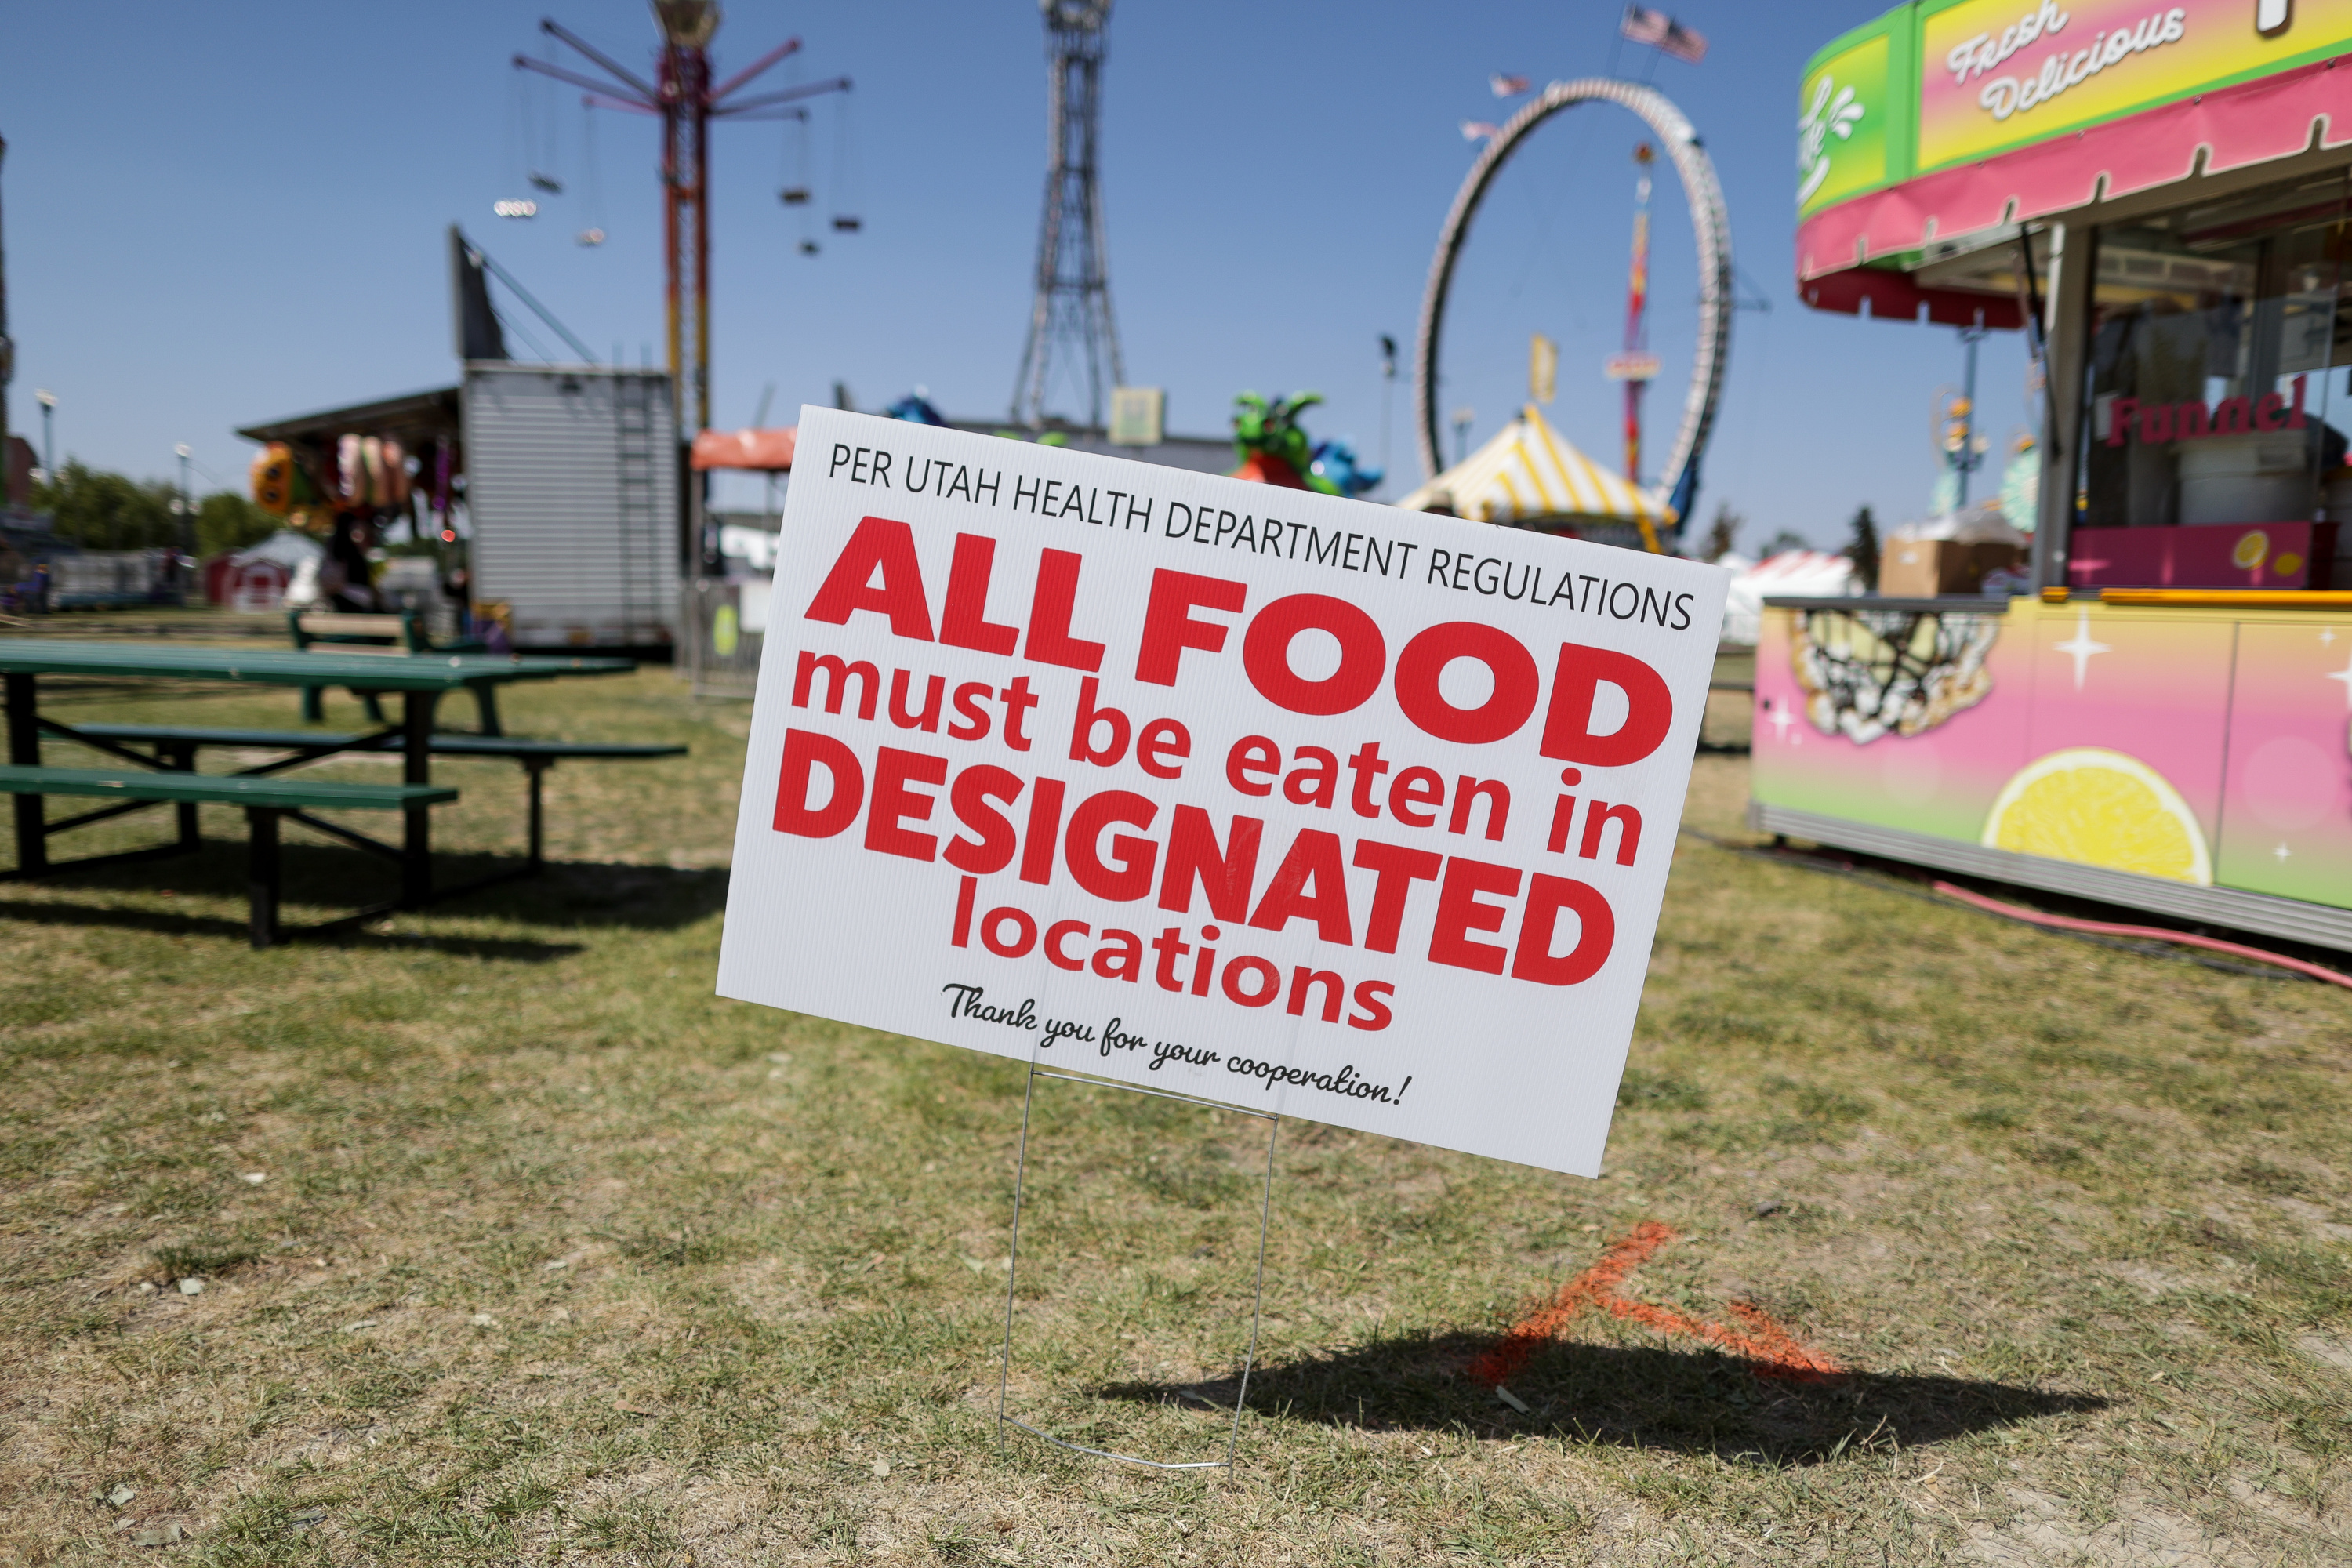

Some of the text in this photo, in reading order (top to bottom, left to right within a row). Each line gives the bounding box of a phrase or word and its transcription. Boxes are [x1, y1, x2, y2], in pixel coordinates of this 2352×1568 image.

[1947, 1, 2070, 85] Fresh
[1979, 7, 2186, 121] Delicious
[2107, 374, 2308, 448] Funnel
[829, 442, 1694, 630] PER UTAH HEALTH DEPARTMENT REGULATIONS
[804, 516, 1673, 768] ALL FOOD
[791, 650, 1643, 867] must be eaten in
[772, 728, 1615, 986] DESIGNATED
[951, 874, 1396, 1032] locations
[942, 982, 1413, 1105] Thank you for your cooperation!
